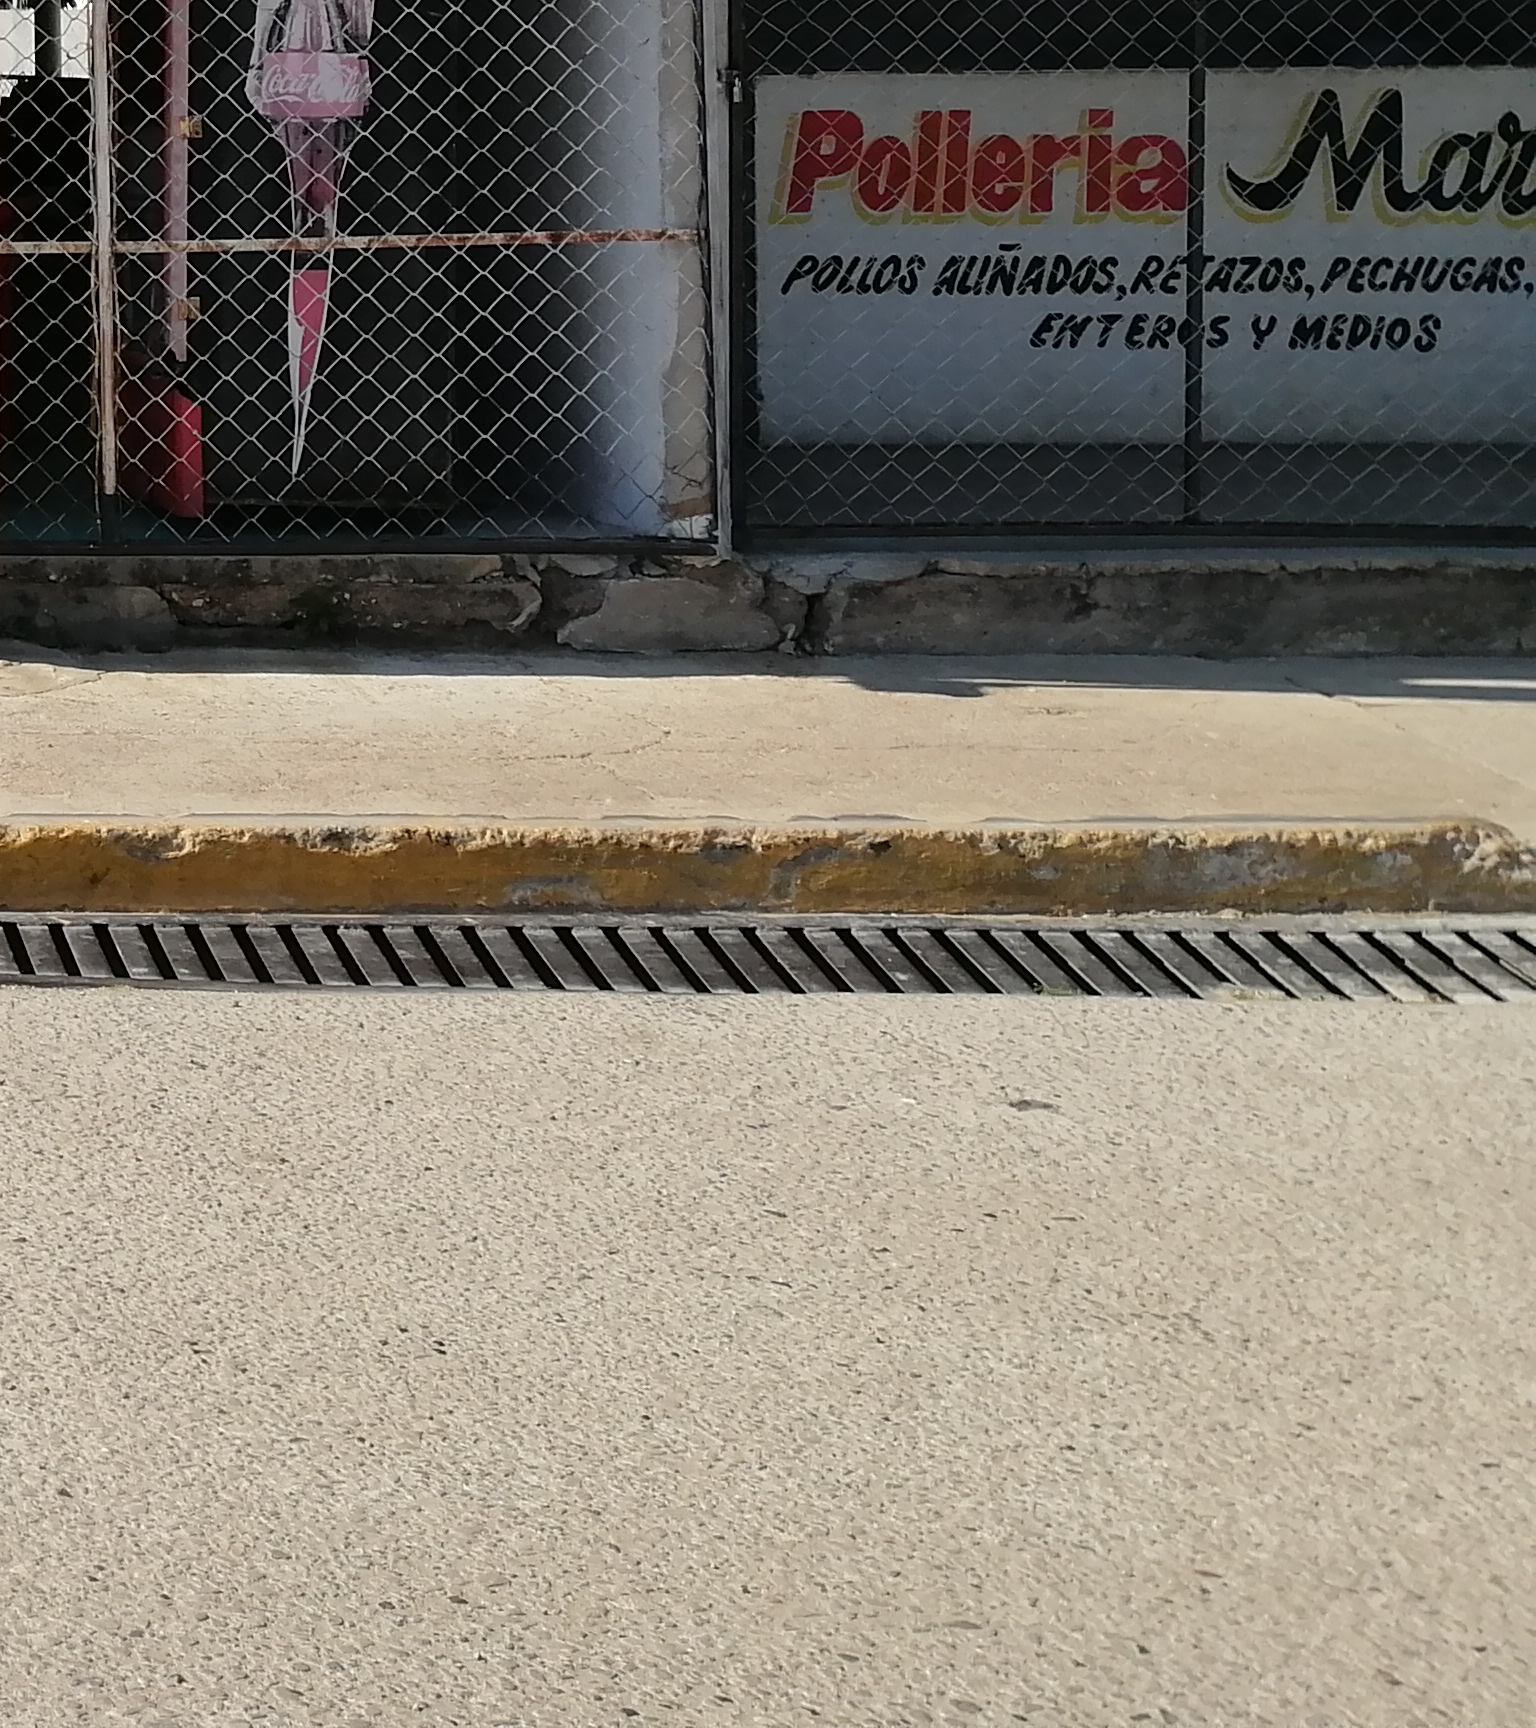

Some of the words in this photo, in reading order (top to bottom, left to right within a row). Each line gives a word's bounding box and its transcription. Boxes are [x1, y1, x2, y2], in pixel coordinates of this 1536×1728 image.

[768, 108, 1188, 225] Polleria
[780, 255, 926, 296] POLLOS
[1251, 315, 1278, 350] Y
[1288, 313, 1442, 353] MEDIOS
